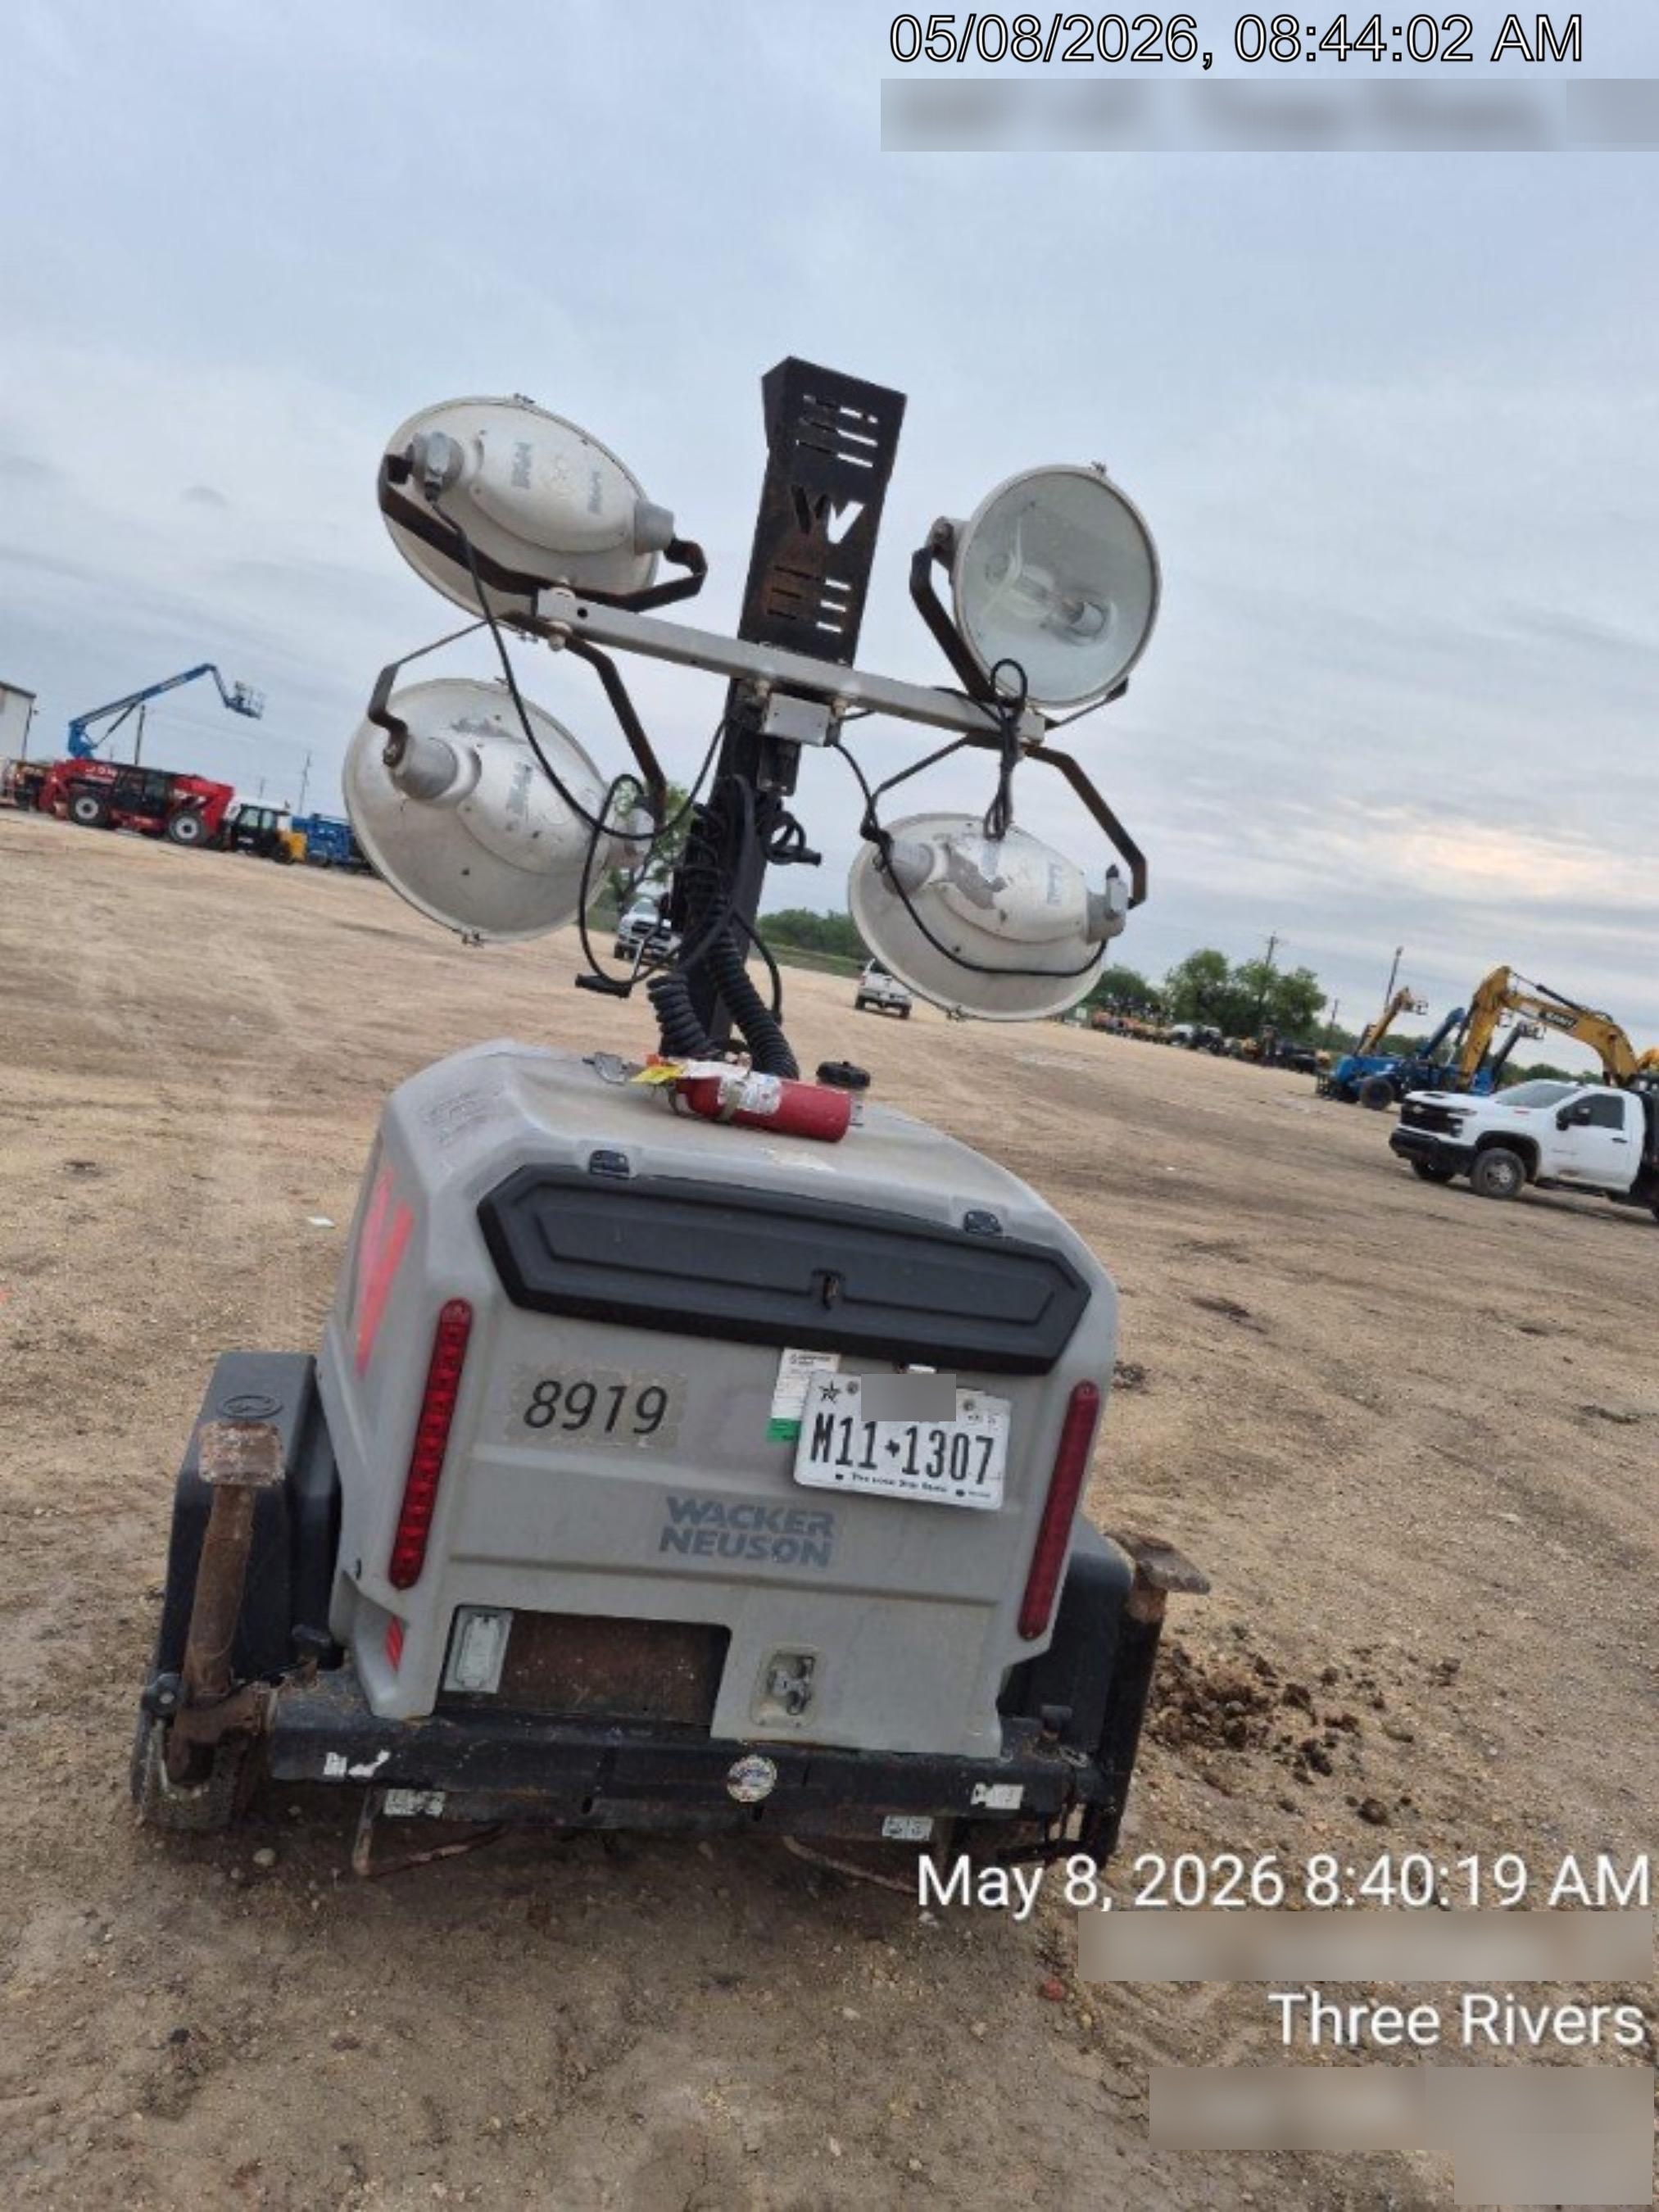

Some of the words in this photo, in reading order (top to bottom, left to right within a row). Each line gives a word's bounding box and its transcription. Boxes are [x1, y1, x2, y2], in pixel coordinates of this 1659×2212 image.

[523, 1380, 668, 1435] 8919
[902, 1426, 994, 1484] 1307
[666, 1496, 835, 1537] WACKER
[659, 1525, 833, 1568] NEUSON
